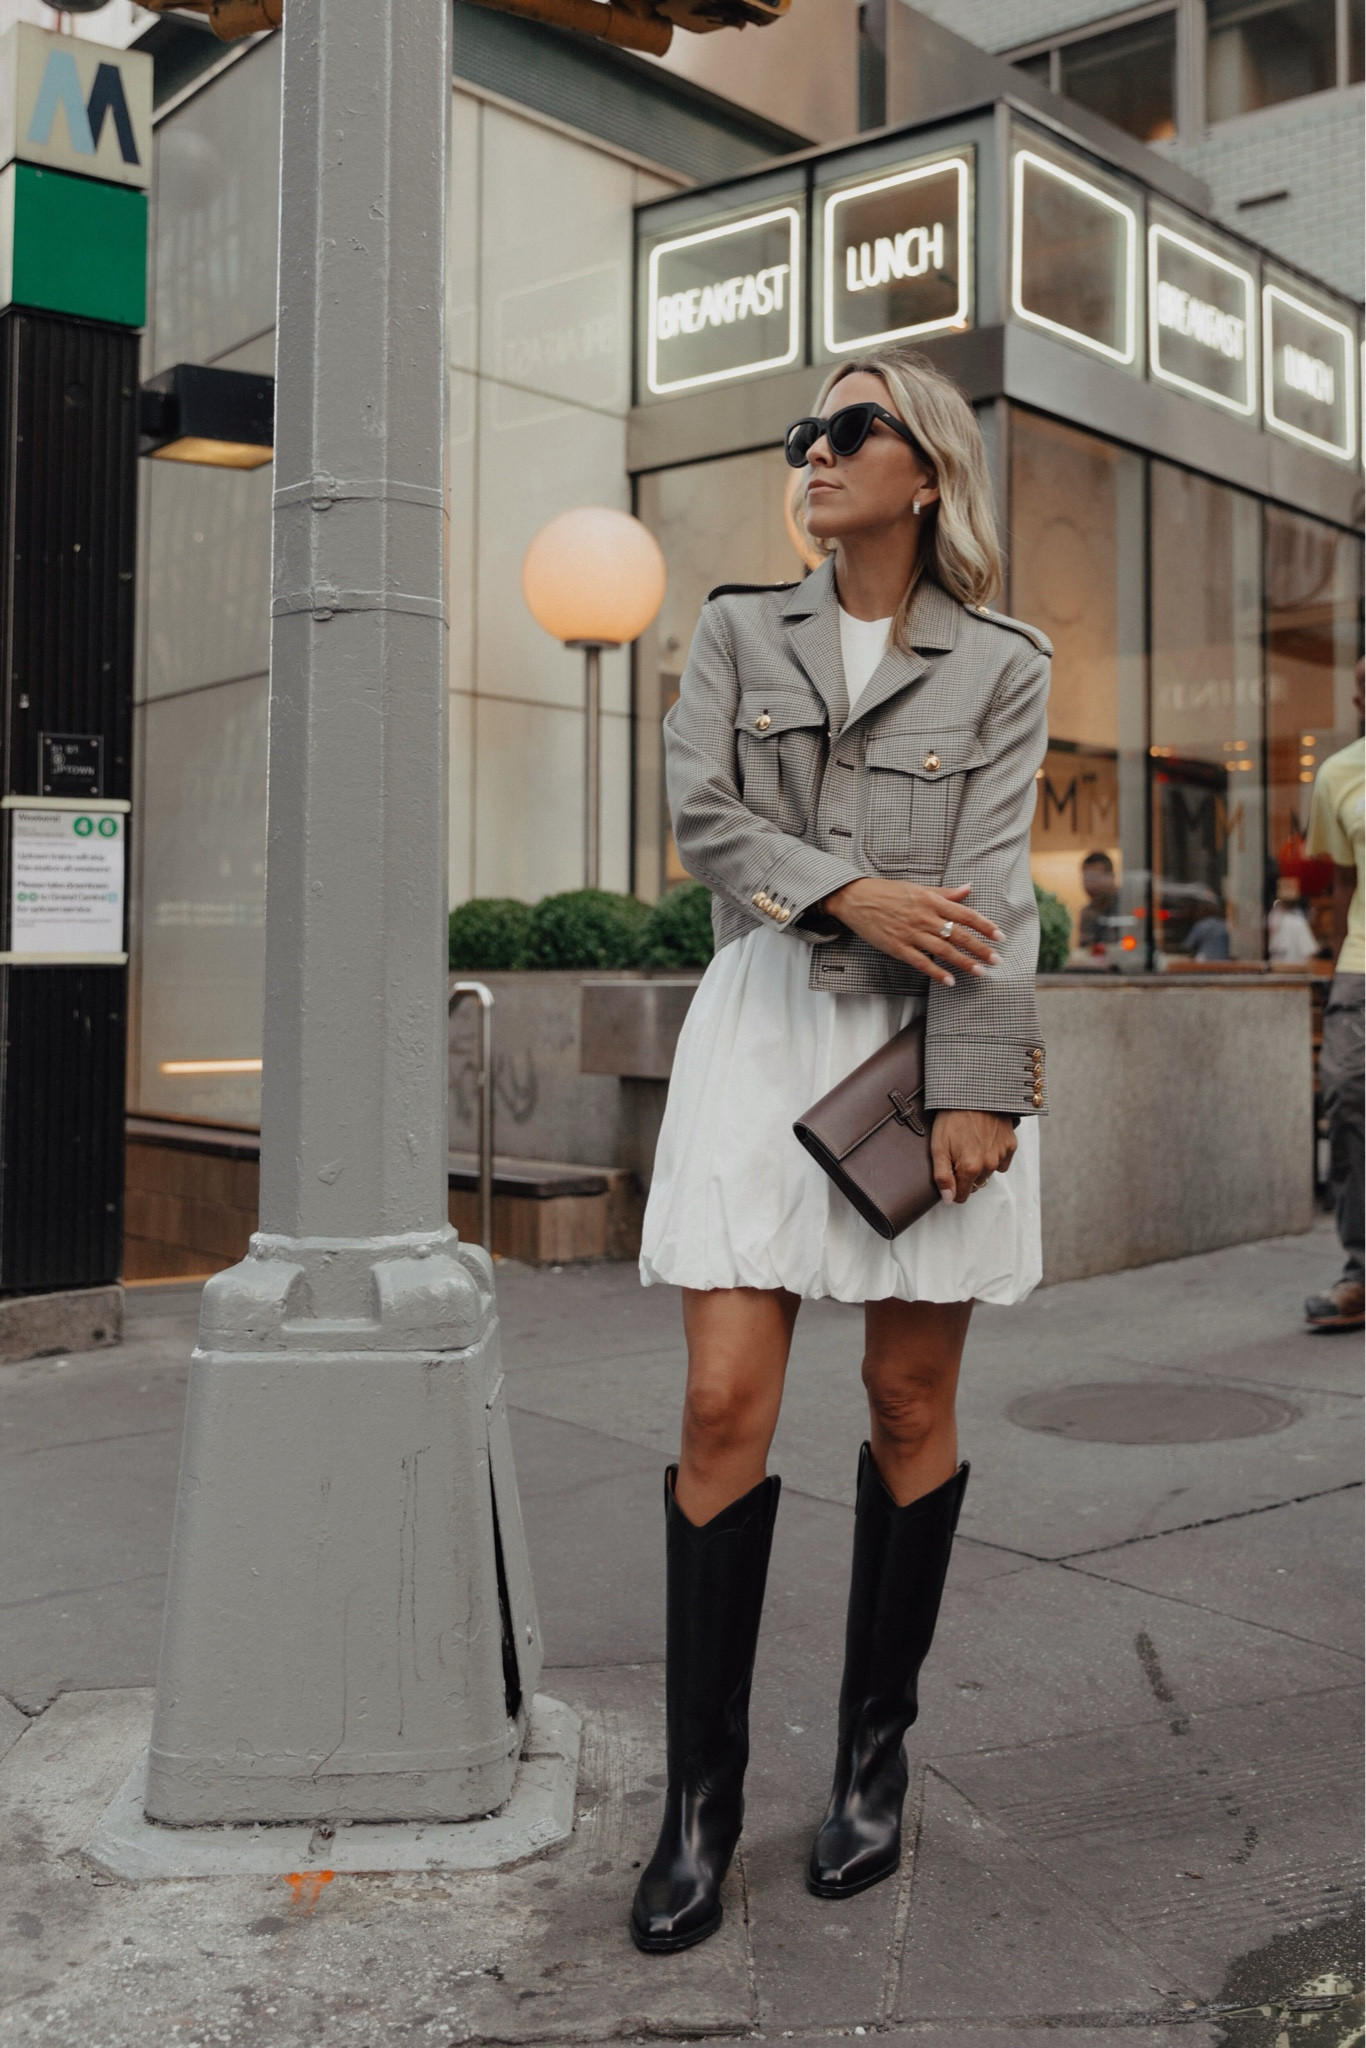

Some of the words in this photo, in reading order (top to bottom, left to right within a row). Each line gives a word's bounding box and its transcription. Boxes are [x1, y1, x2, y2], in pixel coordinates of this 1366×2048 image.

[847, 222, 943, 292] LUNCH
[657, 263, 790, 340] BREAKFAST
[1284, 344, 1335, 405] LUNCH
